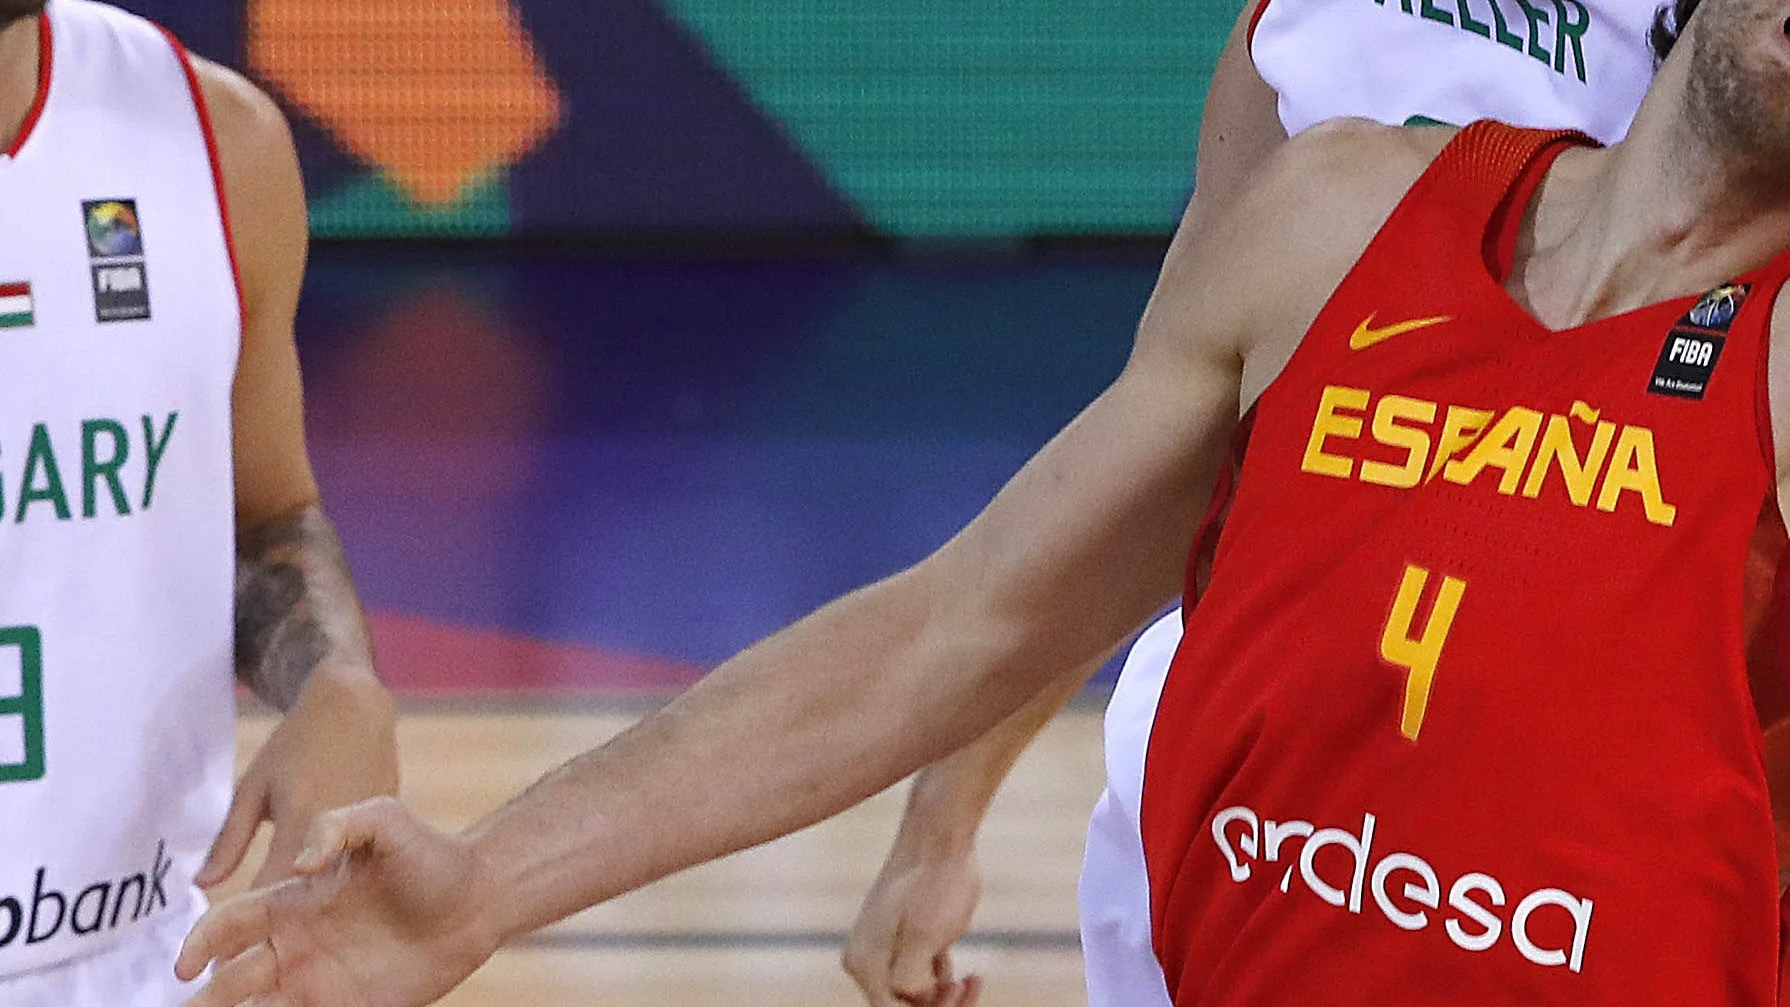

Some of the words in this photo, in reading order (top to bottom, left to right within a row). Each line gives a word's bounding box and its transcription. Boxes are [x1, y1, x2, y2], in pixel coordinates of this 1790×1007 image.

[1669, 337, 1713, 367] FIBA
[0, 411, 178, 523] ARY
[1301, 386, 1677, 527] ESPAÑA
[1380, 565, 1466, 742] 4
